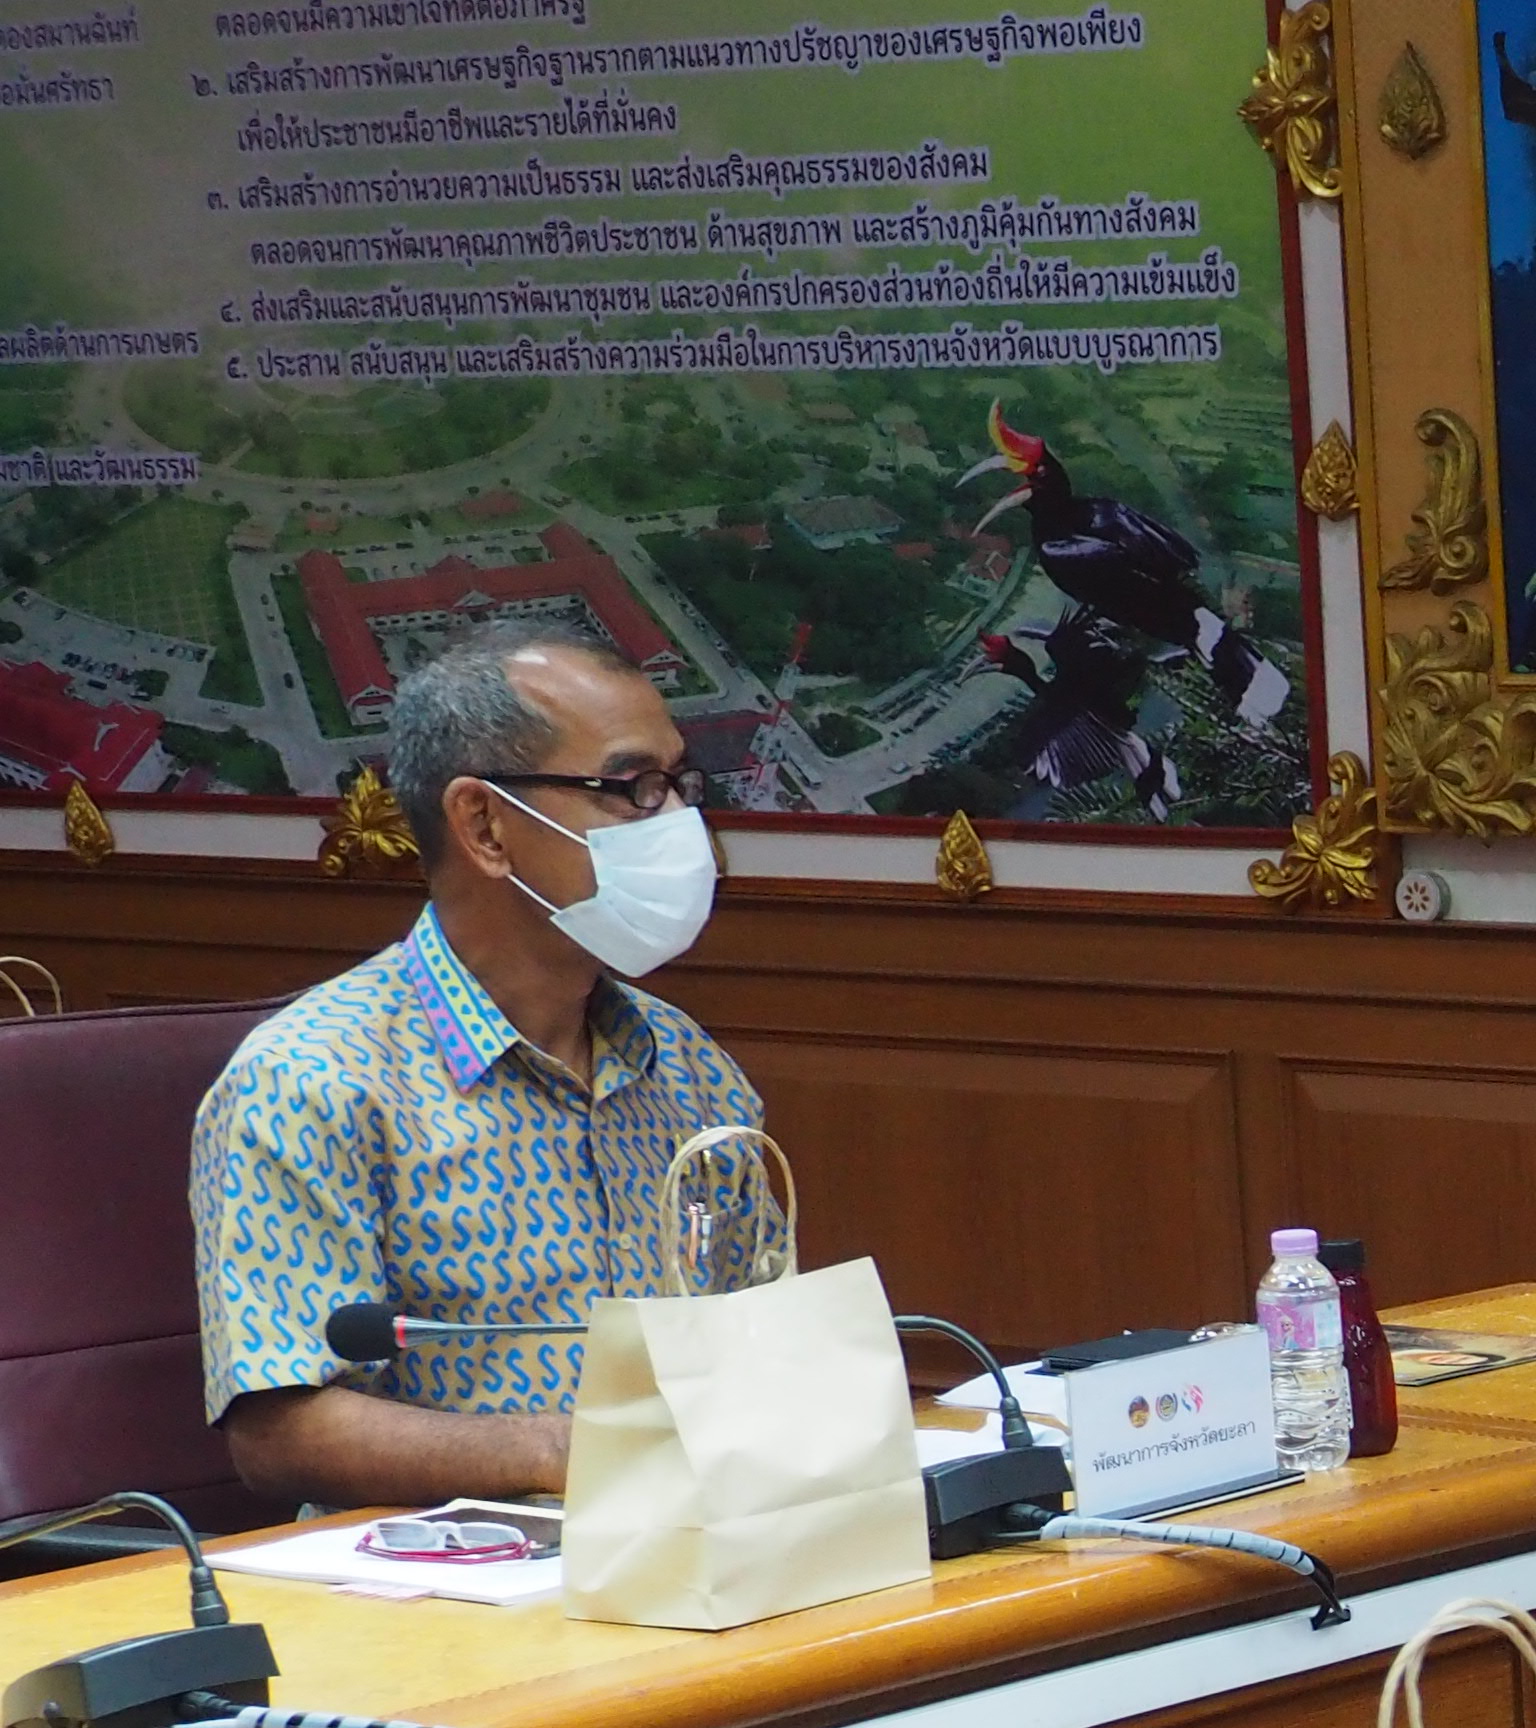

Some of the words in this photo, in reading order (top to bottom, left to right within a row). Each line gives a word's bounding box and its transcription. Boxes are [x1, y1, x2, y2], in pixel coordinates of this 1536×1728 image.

[237, 88, 677, 152] เพื่อให้ประชาชนมีอาชีพและรายได้ที่มั่นคง
[238, 157, 622, 209] เสริมสร้างการอำนวยความเป็นธรรม
[631, 143, 988, 197] และส่งเสริมคุณธรรมของสังคม
[250, 220, 698, 267] ตลอดจนการพัฒนาคุณภาพชีวิตประชาชน
[707, 212, 842, 257] ด้านสุขภาพ
[852, 196, 1197, 251] และสร้างภูมิคุ้มกันทางสังคม
[252, 281, 650, 327] ส่งเสริมและสนับสนุนการพัฒนาชุมชน
[660, 250, 1236, 311] และองค์กรปกครองส่วนท้องถิ่นให้มีความเข้มแข็ง
[256, 347, 341, 379] ประสาน
[351, 342, 448, 384] สนับสนุน
[1091, 1420, 1257, 1473] พัฒนาการจังหวัดยะลา
